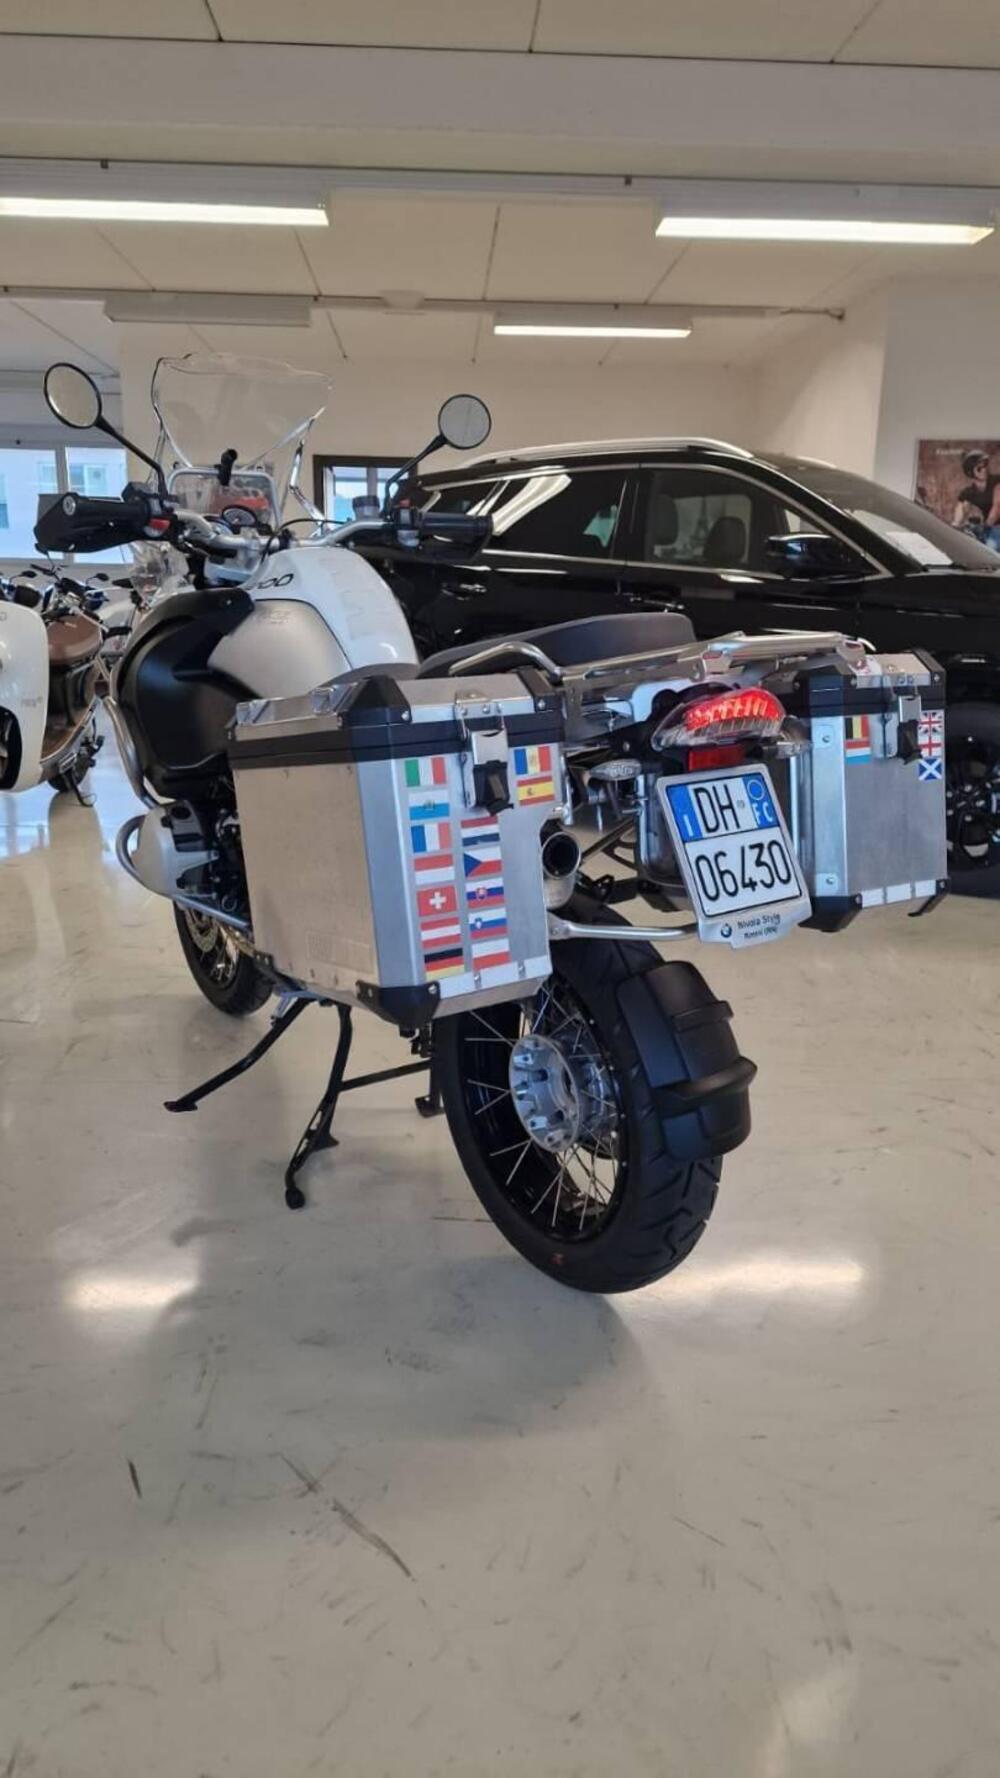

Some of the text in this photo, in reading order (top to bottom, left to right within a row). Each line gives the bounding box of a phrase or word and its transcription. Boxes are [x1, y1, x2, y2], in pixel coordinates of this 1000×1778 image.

[693, 784, 741, 833] DH
[752, 802, 774, 825] FC
[695, 840, 792, 902] 06430
